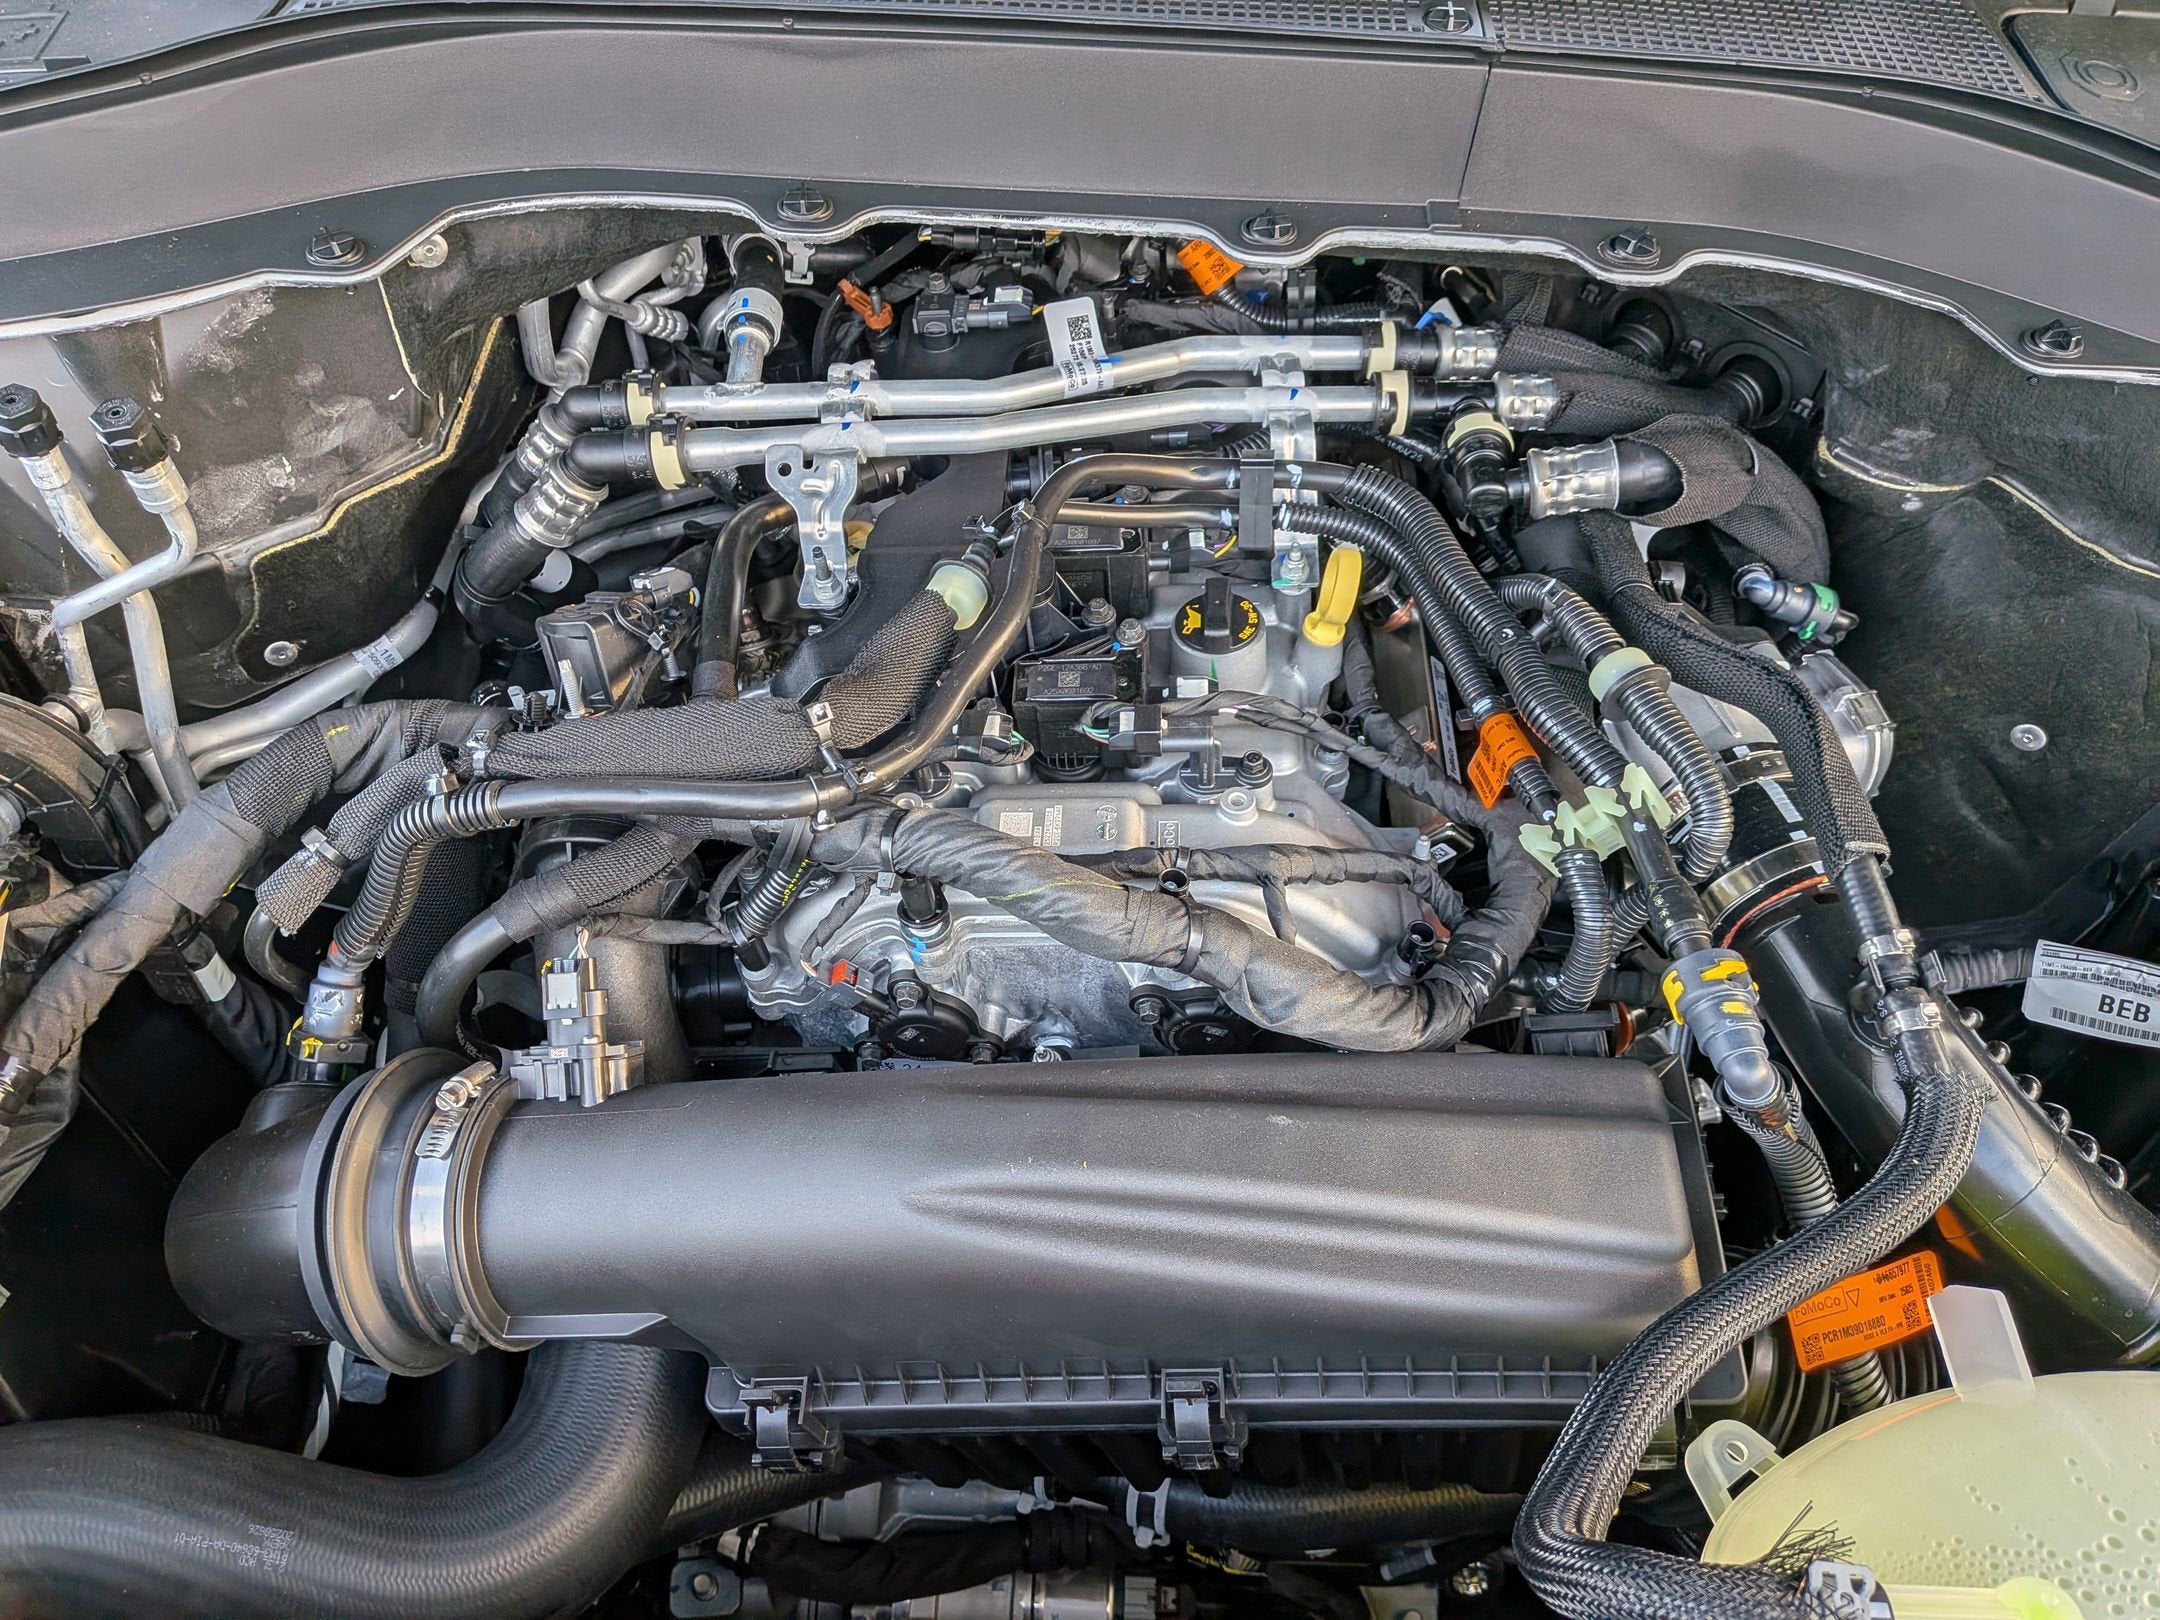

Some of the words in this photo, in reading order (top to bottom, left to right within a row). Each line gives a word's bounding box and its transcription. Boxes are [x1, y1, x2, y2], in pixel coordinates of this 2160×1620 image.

[1240, 600, 1258, 624] 5W-30
[1238, 625, 1256, 640] SAE
[2098, 993, 2151, 1023] BEB
[1794, 1294, 1841, 1320] FoMoCo
